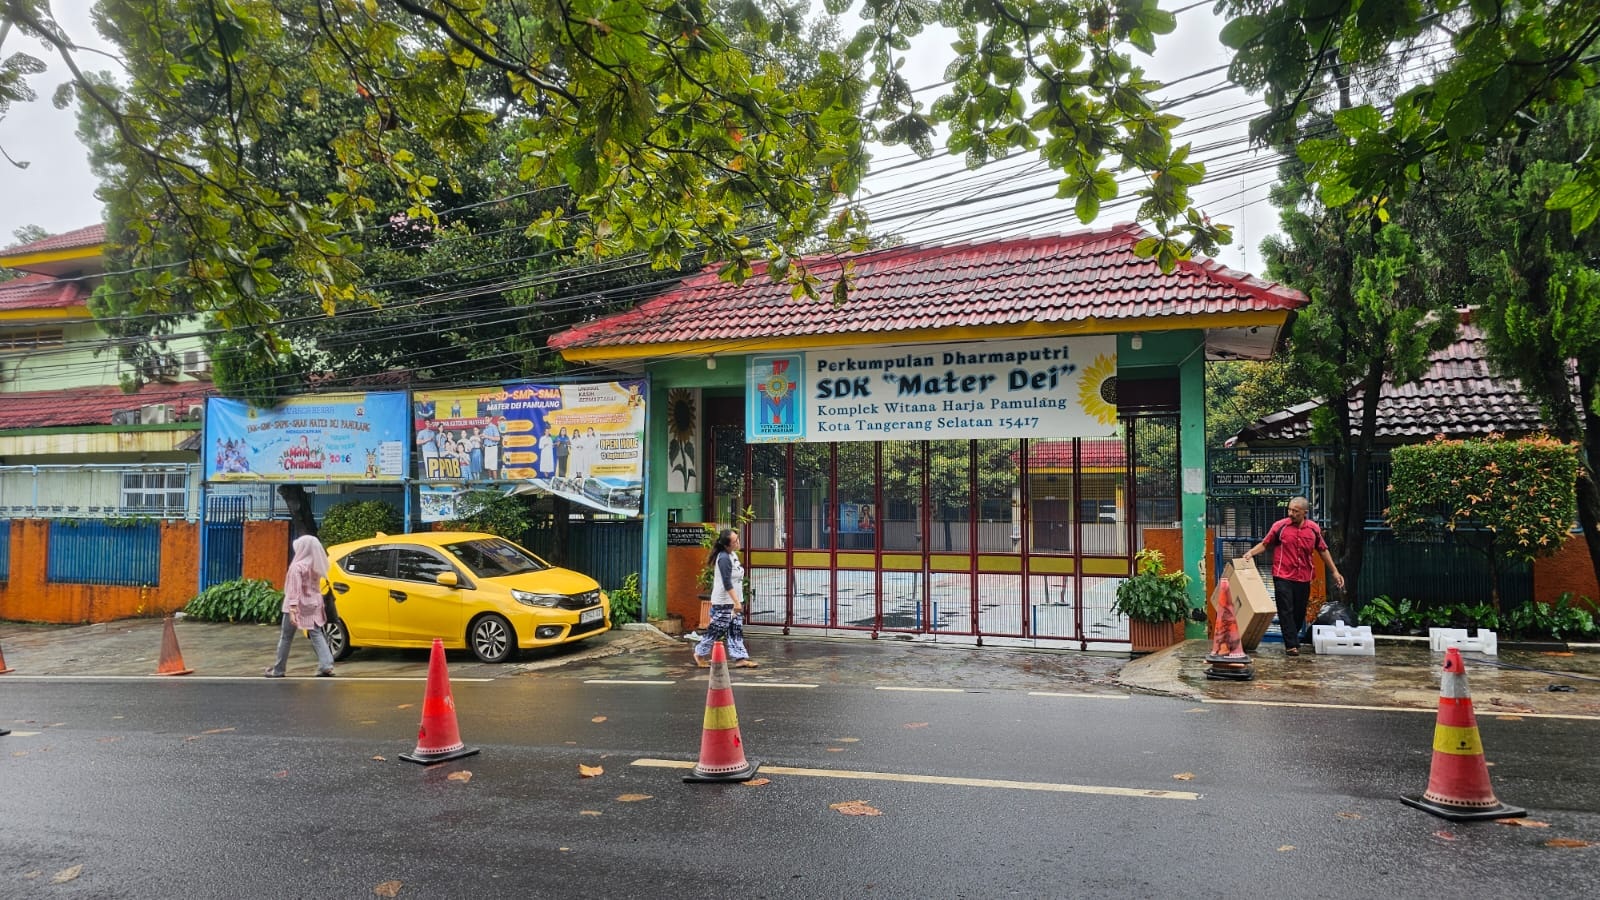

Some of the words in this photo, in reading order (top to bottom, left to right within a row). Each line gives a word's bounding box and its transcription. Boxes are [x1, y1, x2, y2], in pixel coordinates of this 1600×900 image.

[817, 354, 934, 372] Perkumpulan
[943, 346, 1069, 364] Dharmaputri
[816, 376, 872, 399] SDK
[487, 403, 510, 411] MATER
[522, 401, 560, 409] PAMULANG
[818, 404, 879, 417] Komplek
[884, 402, 936, 413] Witana
[943, 400, 984, 412] Harja
[990, 397, 1067, 410] Pamulang
[818, 421, 851, 432] Kota
[855, 419, 932, 432] Tangerang
[937, 417, 993, 428] Selatan
[1000, 417, 1039, 429] 15417
[600, 438, 619, 450] OPEN
[284, 458, 322, 470] Christmas
[427, 457, 461, 478] PPDB
